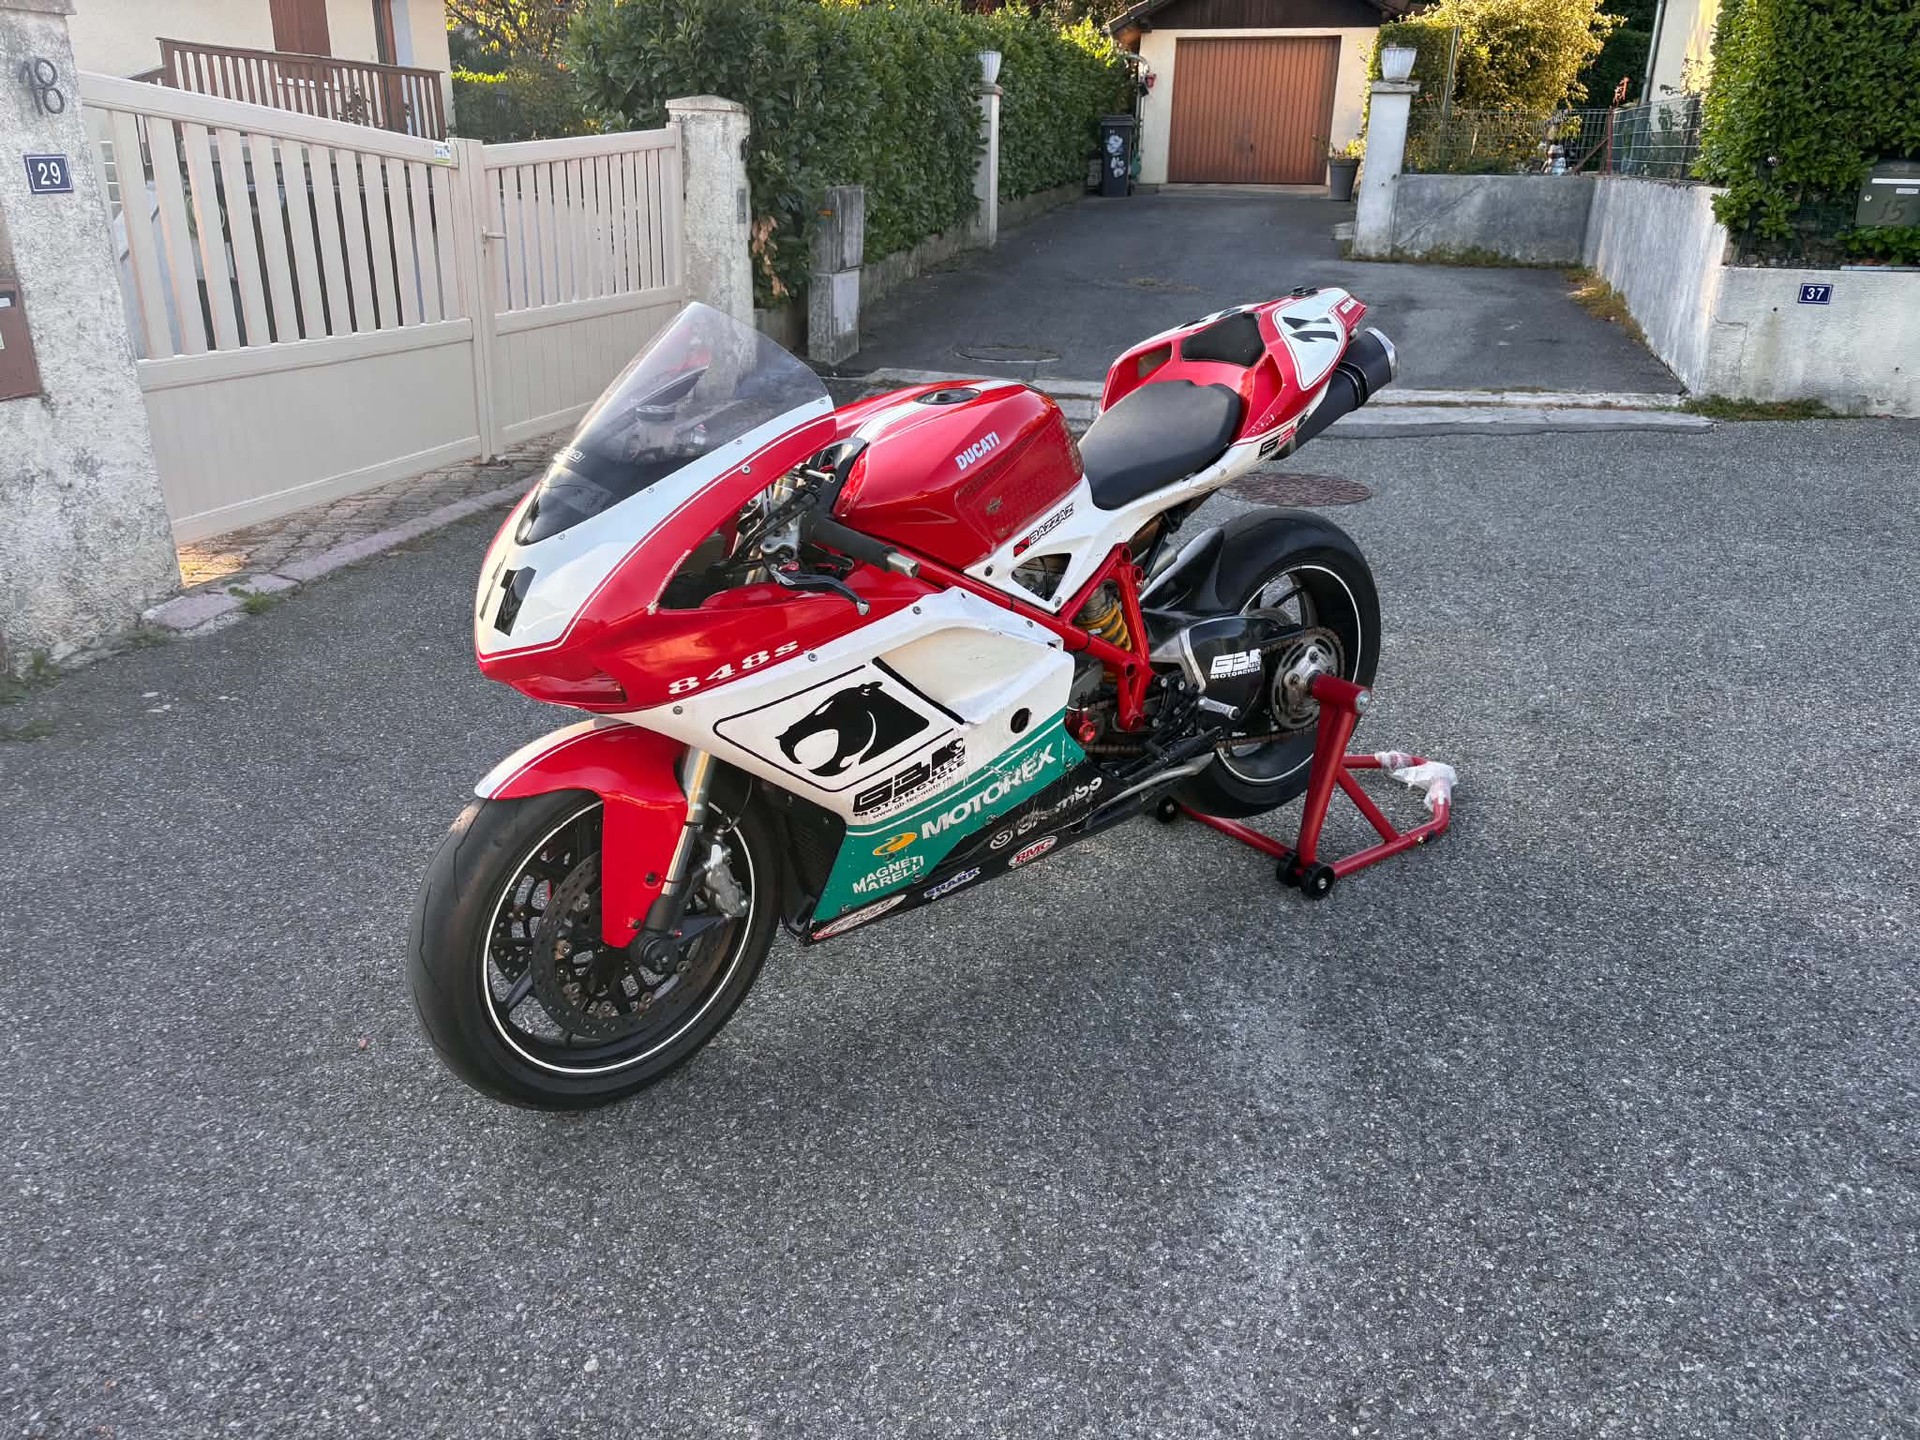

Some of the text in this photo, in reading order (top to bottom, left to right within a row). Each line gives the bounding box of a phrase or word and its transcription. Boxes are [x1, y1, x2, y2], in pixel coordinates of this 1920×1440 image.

[37, 161, 62, 186] 29
[1806, 287, 1825, 300] 37
[954, 431, 1001, 471] DUCATI
[1210, 666, 1261, 680] MOTORCYCLE
[854, 760, 966, 817] MOTORCYCLE
[921, 742, 1057, 839] MOTOREX
[853, 855, 924, 893] MAGNETI
[853, 860, 924, 894] MARELLI
